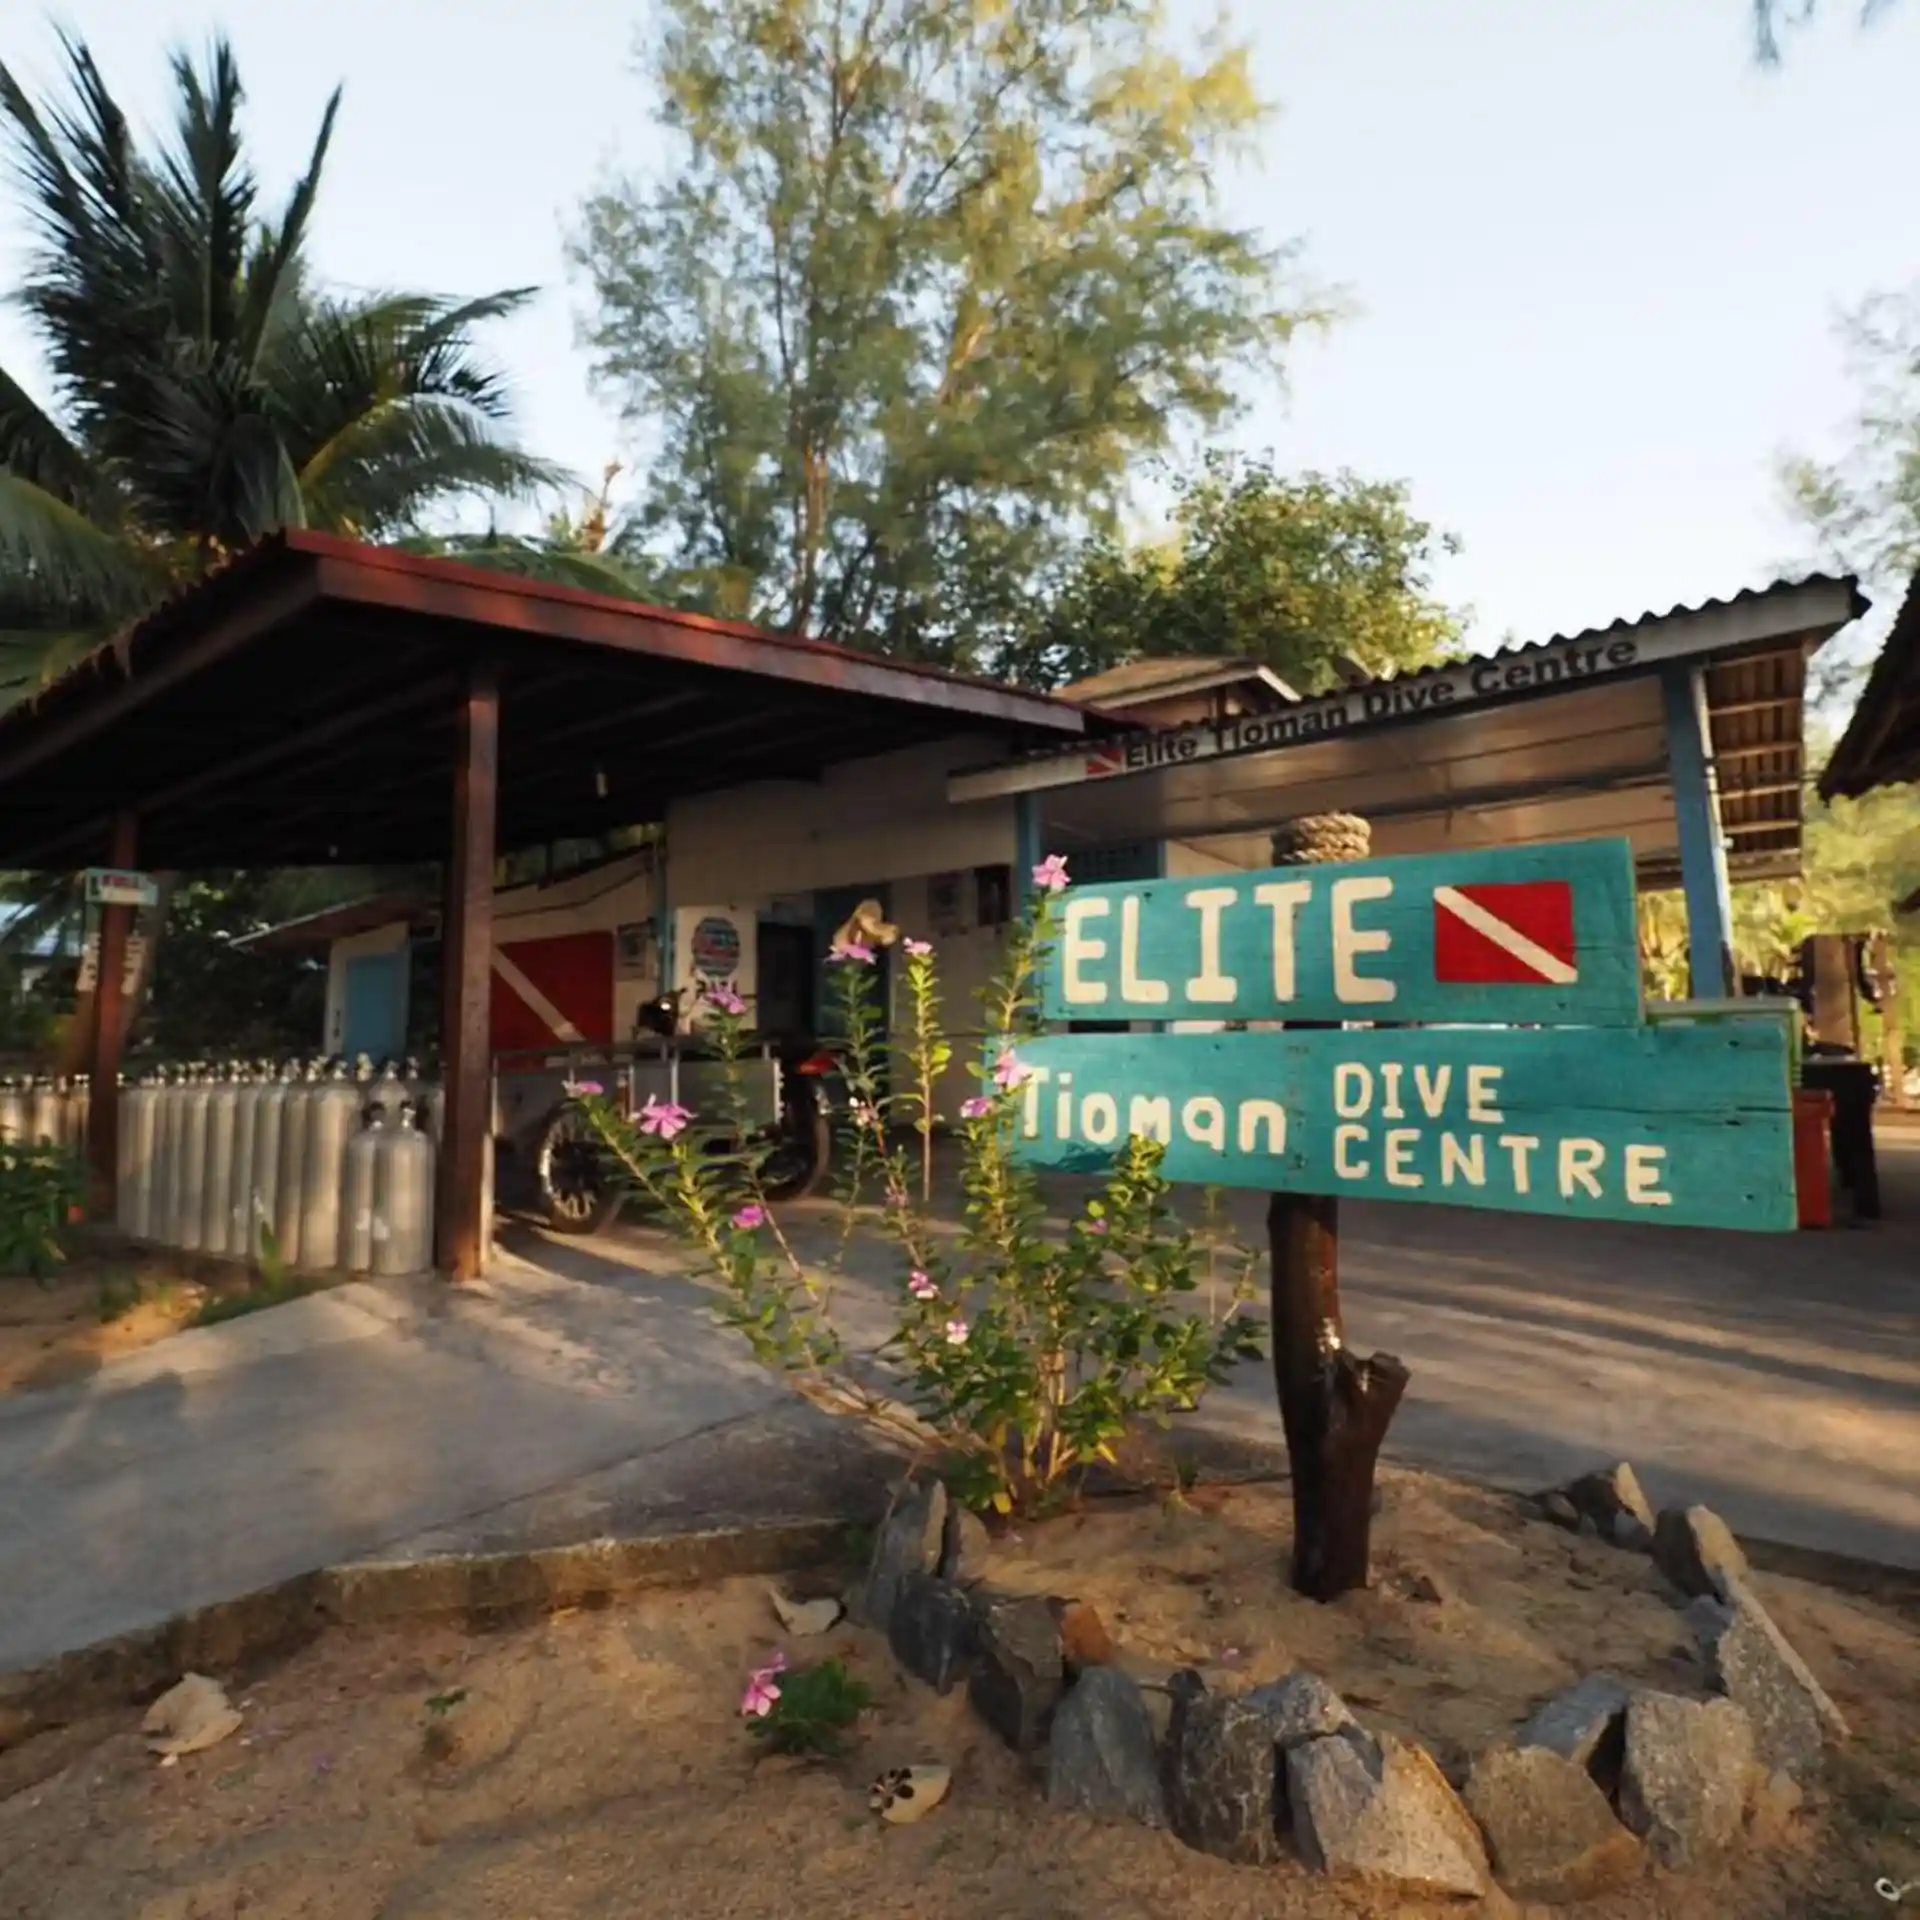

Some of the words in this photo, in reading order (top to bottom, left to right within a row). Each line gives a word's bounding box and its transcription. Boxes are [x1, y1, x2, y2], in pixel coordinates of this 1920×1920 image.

[1126, 733, 1198, 768] Elite
[1213, 708, 1348, 752] Tioman
[1363, 681, 1455, 718] Dive
[1470, 640, 1638, 697] Centre
[1062, 877, 1397, 1004] ELITE
[1021, 1066, 1287, 1154] Tioman
[1333, 1063, 1506, 1124] DIVE
[1333, 1127, 1673, 1206] CENTRE
